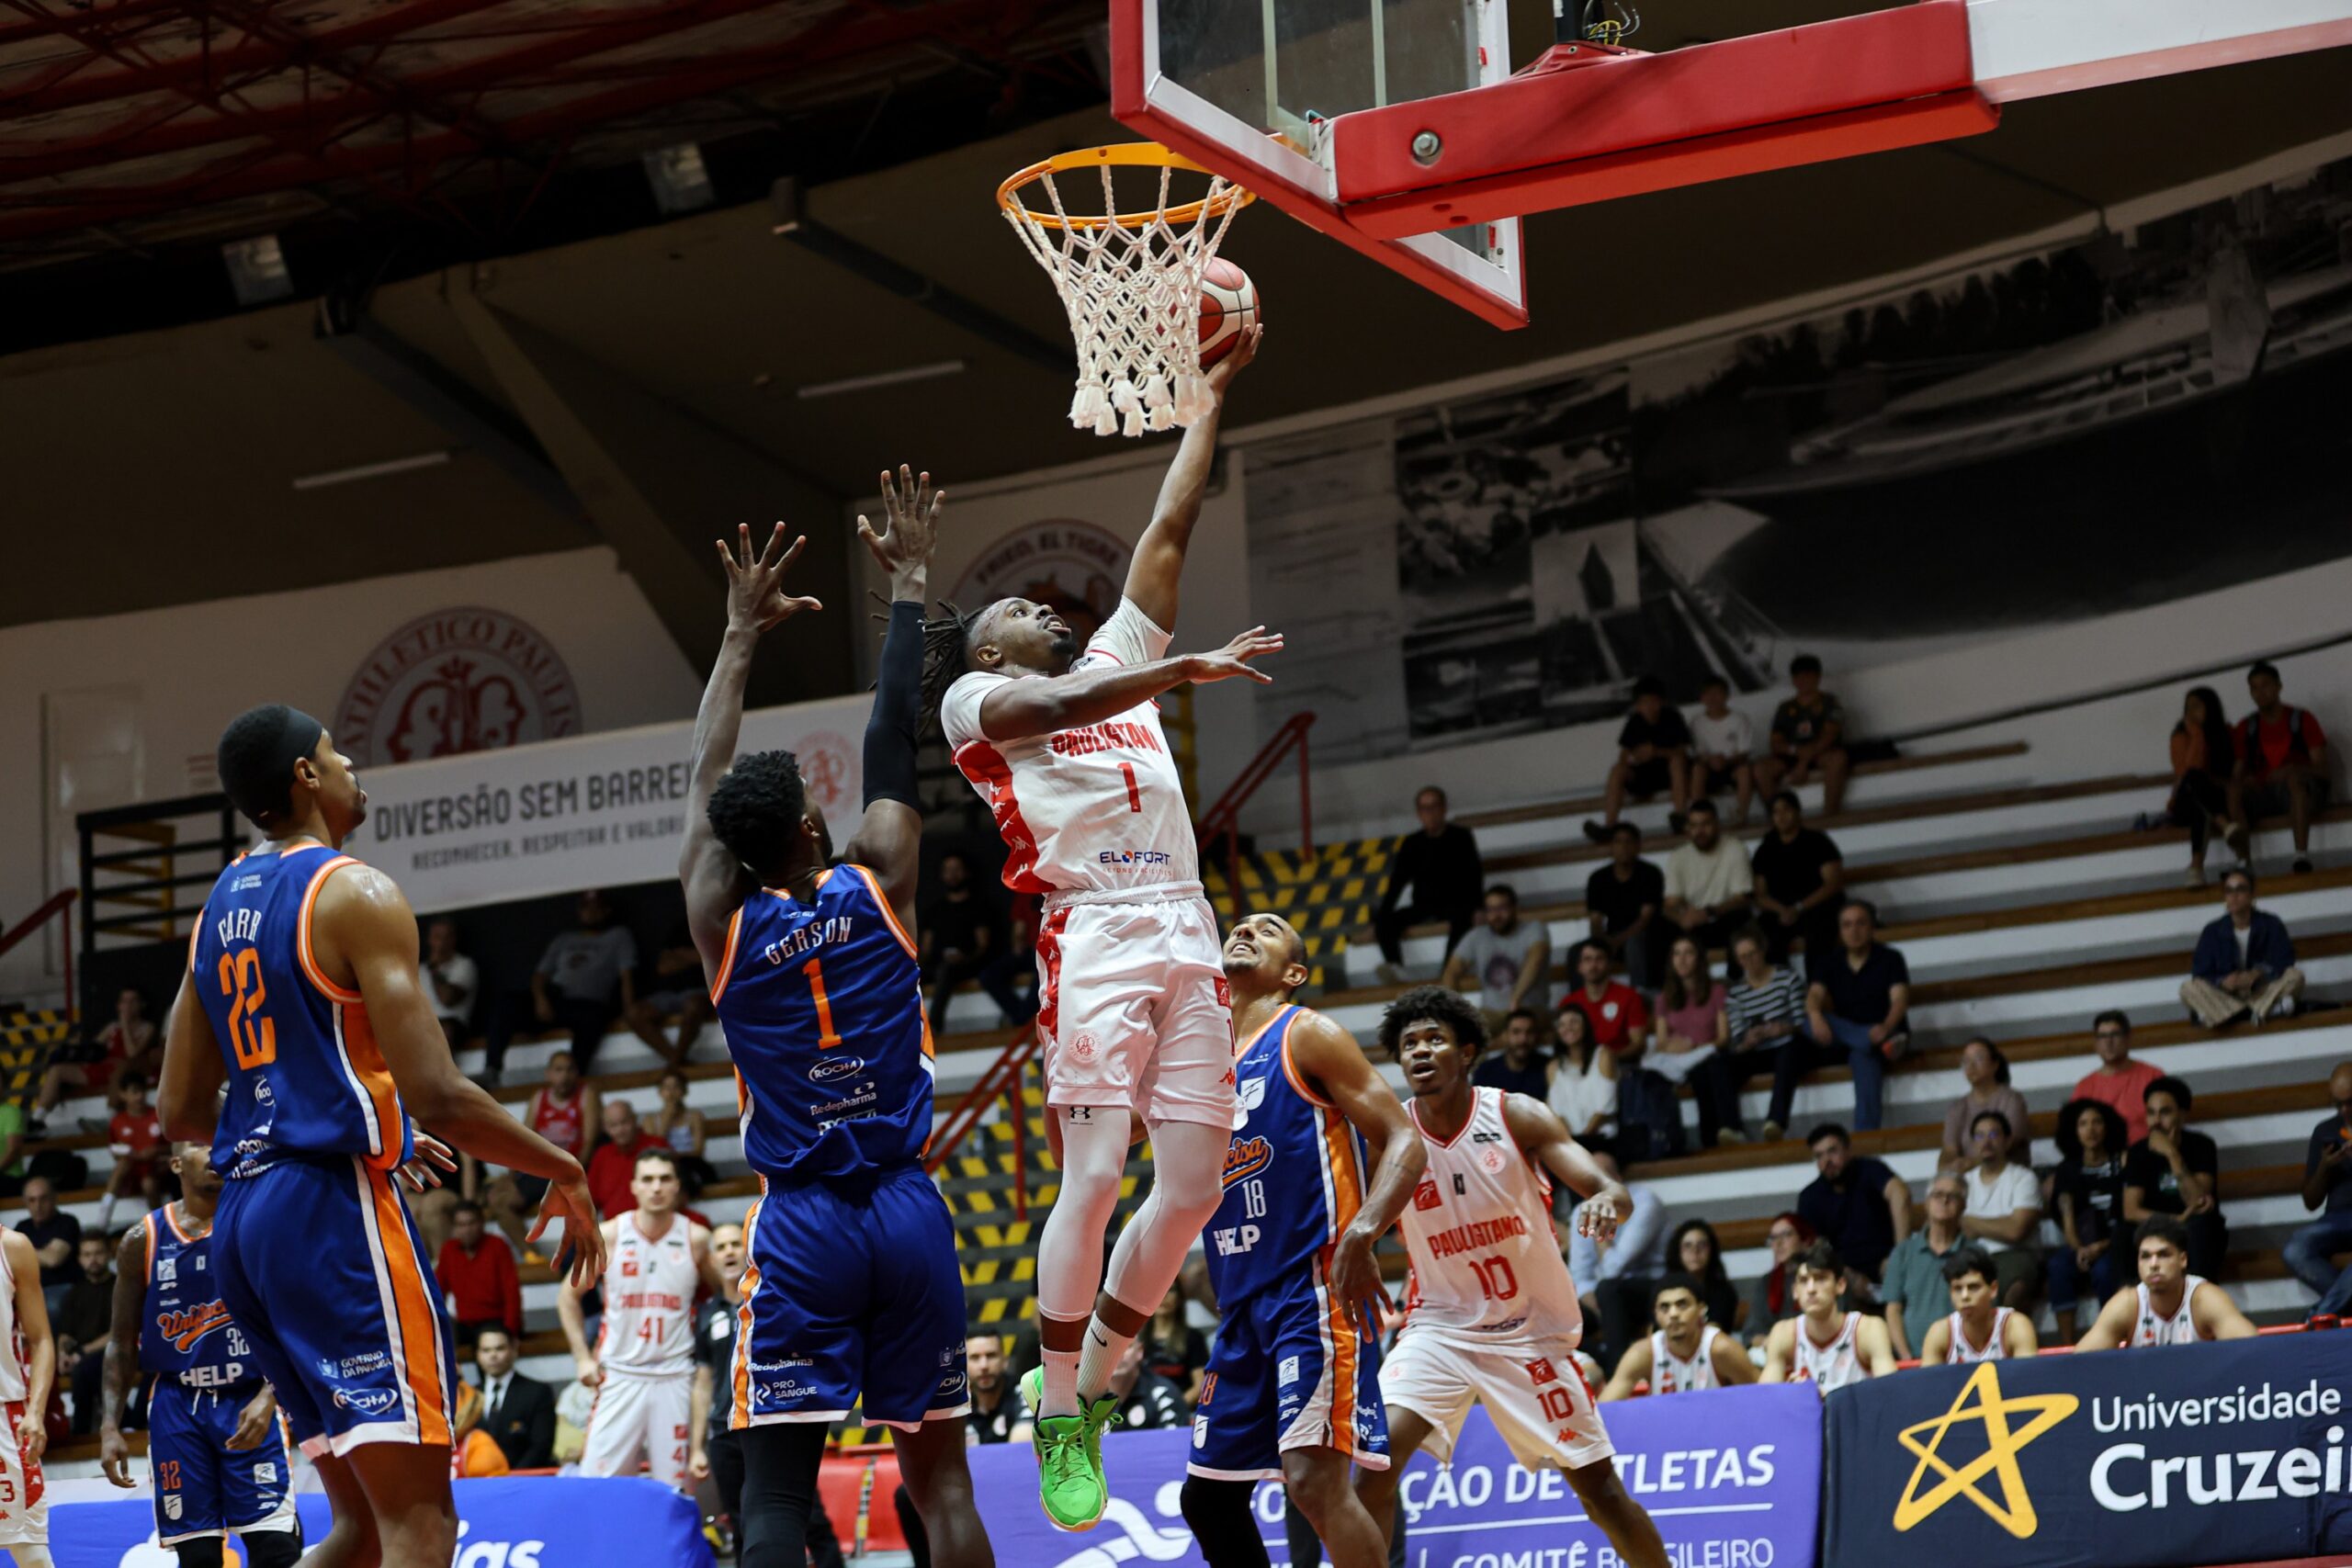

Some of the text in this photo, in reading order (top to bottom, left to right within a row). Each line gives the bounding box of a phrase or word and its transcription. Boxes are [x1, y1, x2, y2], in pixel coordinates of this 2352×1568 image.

[1050, 722, 1164, 758] PAULISTAN
[1116, 761, 1142, 813] 1
[375, 784, 511, 843] DIVERSÃO
[518, 777, 579, 820] SEM
[612, 823, 621, 843] E
[218, 907, 262, 950] CARR
[764, 916, 853, 966] GERSON
[218, 947, 277, 1071] 22
[802, 957, 843, 1051] 1
[813, 1059, 857, 1078] ROCHA
[809, 1091, 878, 1116] Redepharma
[1241, 1179, 1267, 1219] 18
[1213, 1224, 1261, 1257] HELP
[1427, 1215, 1526, 1260] PAULISTANO
[1467, 1254, 1519, 1301] 10
[638, 1316, 665, 1346] 41
[178, 1361, 244, 1388] HELP
[340, 1349, 384, 1369] GOVERNO
[342, 1367, 356, 1379] DA
[749, 1358, 814, 1372] Redepharma
[772, 1379, 796, 1390] PRO
[775, 1386, 818, 1399] SANGUE
[1536, 1387, 1575, 1423] 10
[2092, 1378, 2342, 1433] Universidade
[159, 1460, 183, 1491] 32
[1504, 1461, 1566, 1505] DE
[1572, 1444, 1775, 1498] TLETAS
[2089, 1425, 2352, 1512] Cruzei
